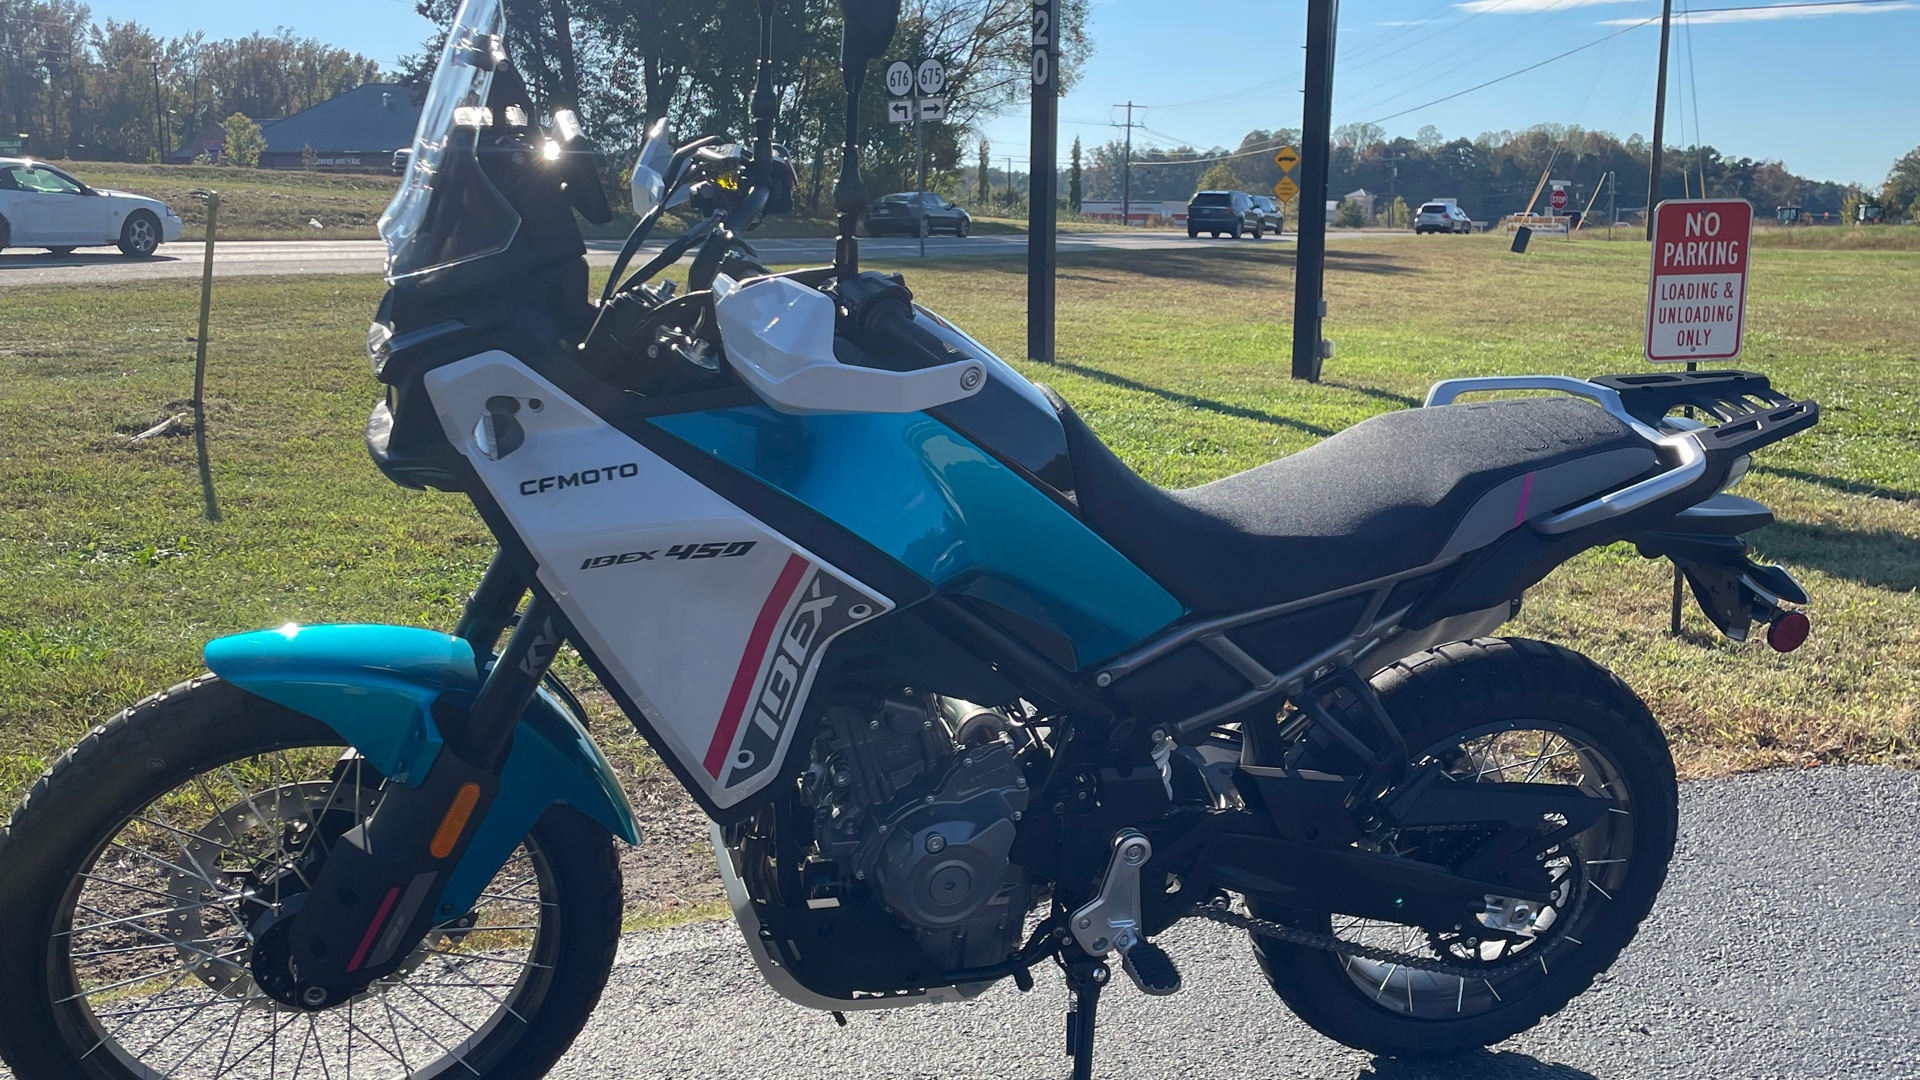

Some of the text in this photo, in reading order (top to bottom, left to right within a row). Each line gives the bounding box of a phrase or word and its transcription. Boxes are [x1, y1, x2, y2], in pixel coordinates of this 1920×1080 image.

[1033, 0, 1049, 86] 20
[889, 70, 909, 88] 676
[921, 67, 942, 85] 675
[1551, 196, 1566, 204] STOP
[1685, 211, 1721, 237] NO
[1663, 240, 1739, 267] PARKING
[1661, 281, 1734, 300] LOADING &
[1658, 305, 1734, 324] UNLOADING
[1677, 328, 1712, 347] ONLY
[519, 462, 639, 496] CFMOTO
[579, 540, 758, 571] IBEX 450
[753, 576, 839, 742] IBEX
